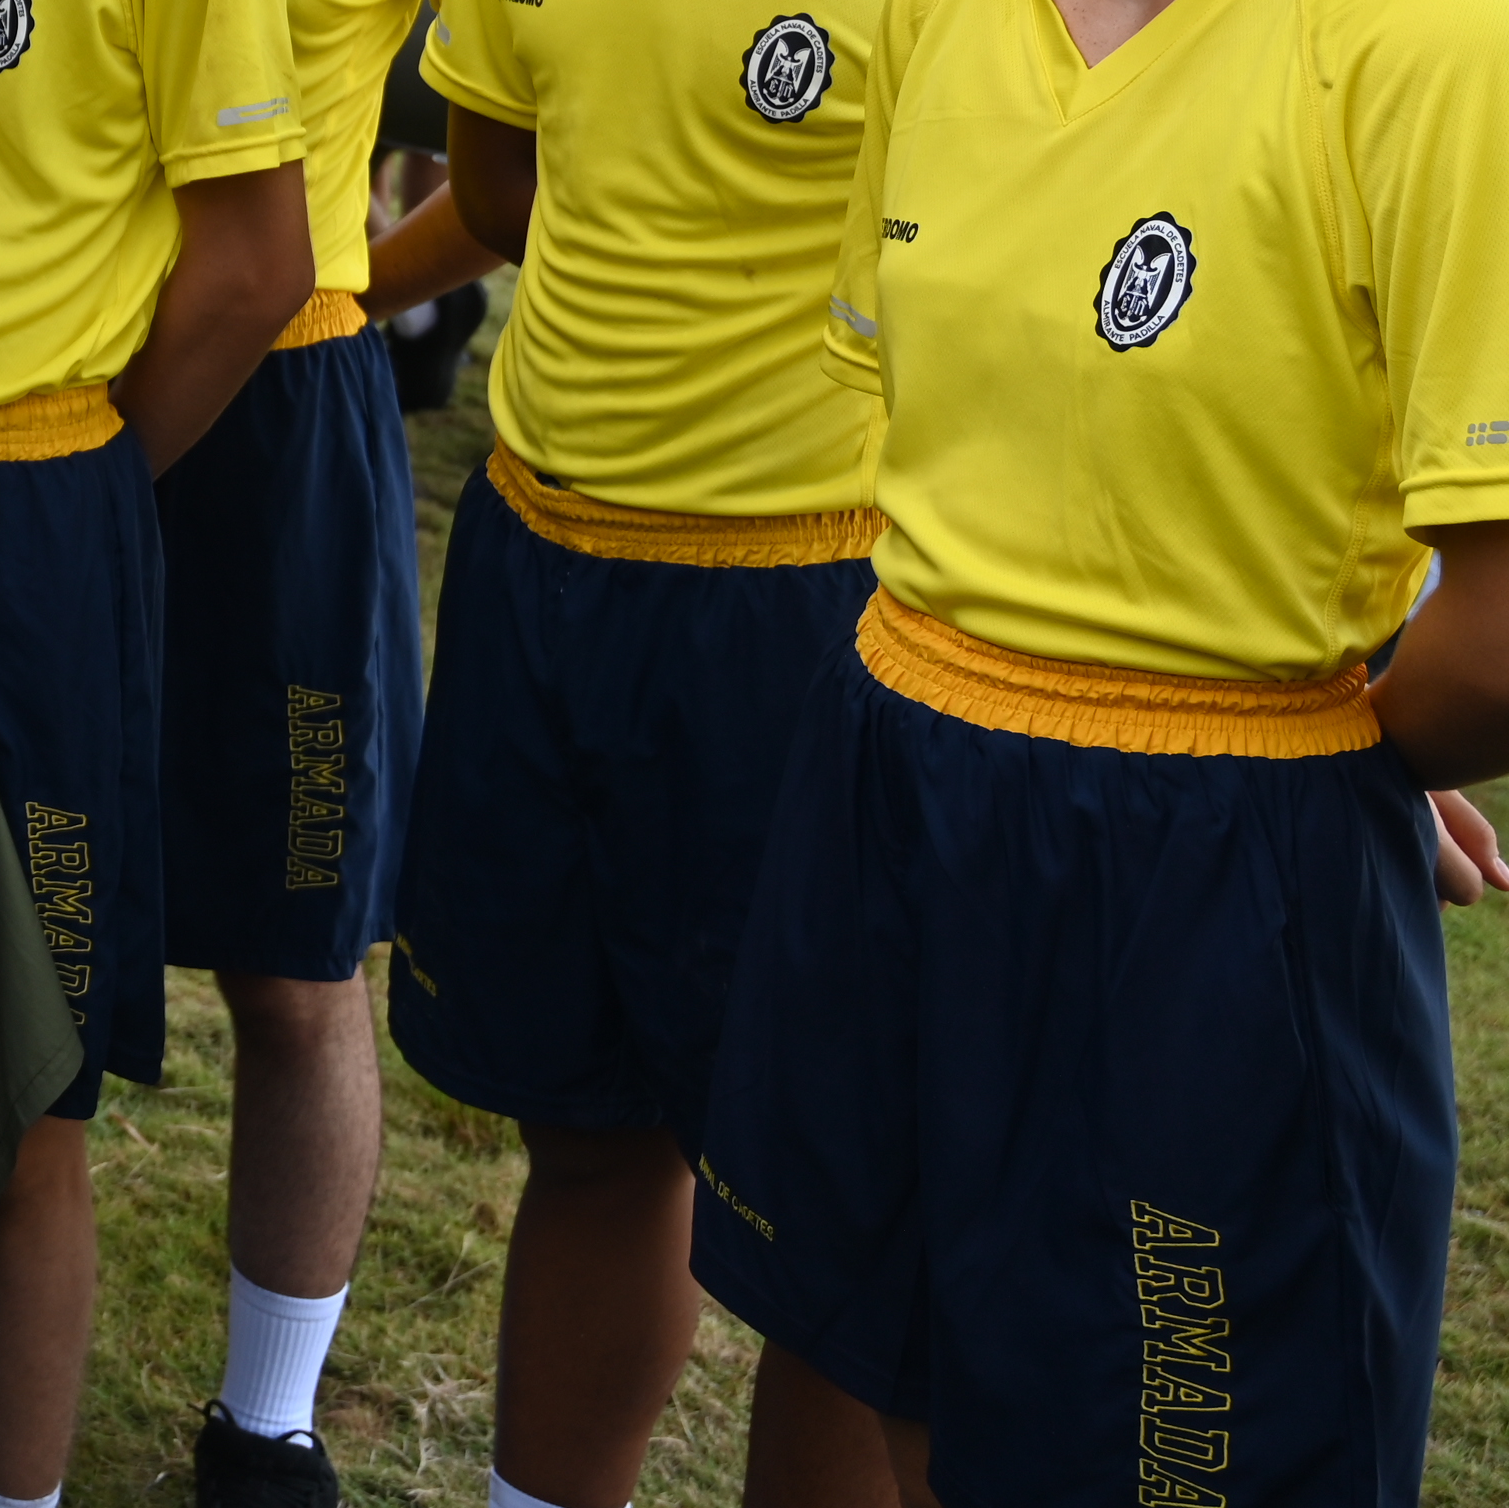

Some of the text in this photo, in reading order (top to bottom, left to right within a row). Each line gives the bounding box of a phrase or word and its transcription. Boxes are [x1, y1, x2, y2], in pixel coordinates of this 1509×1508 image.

[756, 23, 823, 74] ESCUELA NAVAL DE CADETES
[750, 79, 810, 117] ALMIRANTE PADILLA
[1114, 224, 1185, 283] ESCUELA NAVAL DE CADETES
[1103, 299, 1165, 342] ALMIRANTE PADILLA
[286, 685, 345, 889] ARMADA
[26, 802, 92, 1024] ARMAD
[1130, 1199, 1231, 1508] ARMADA
